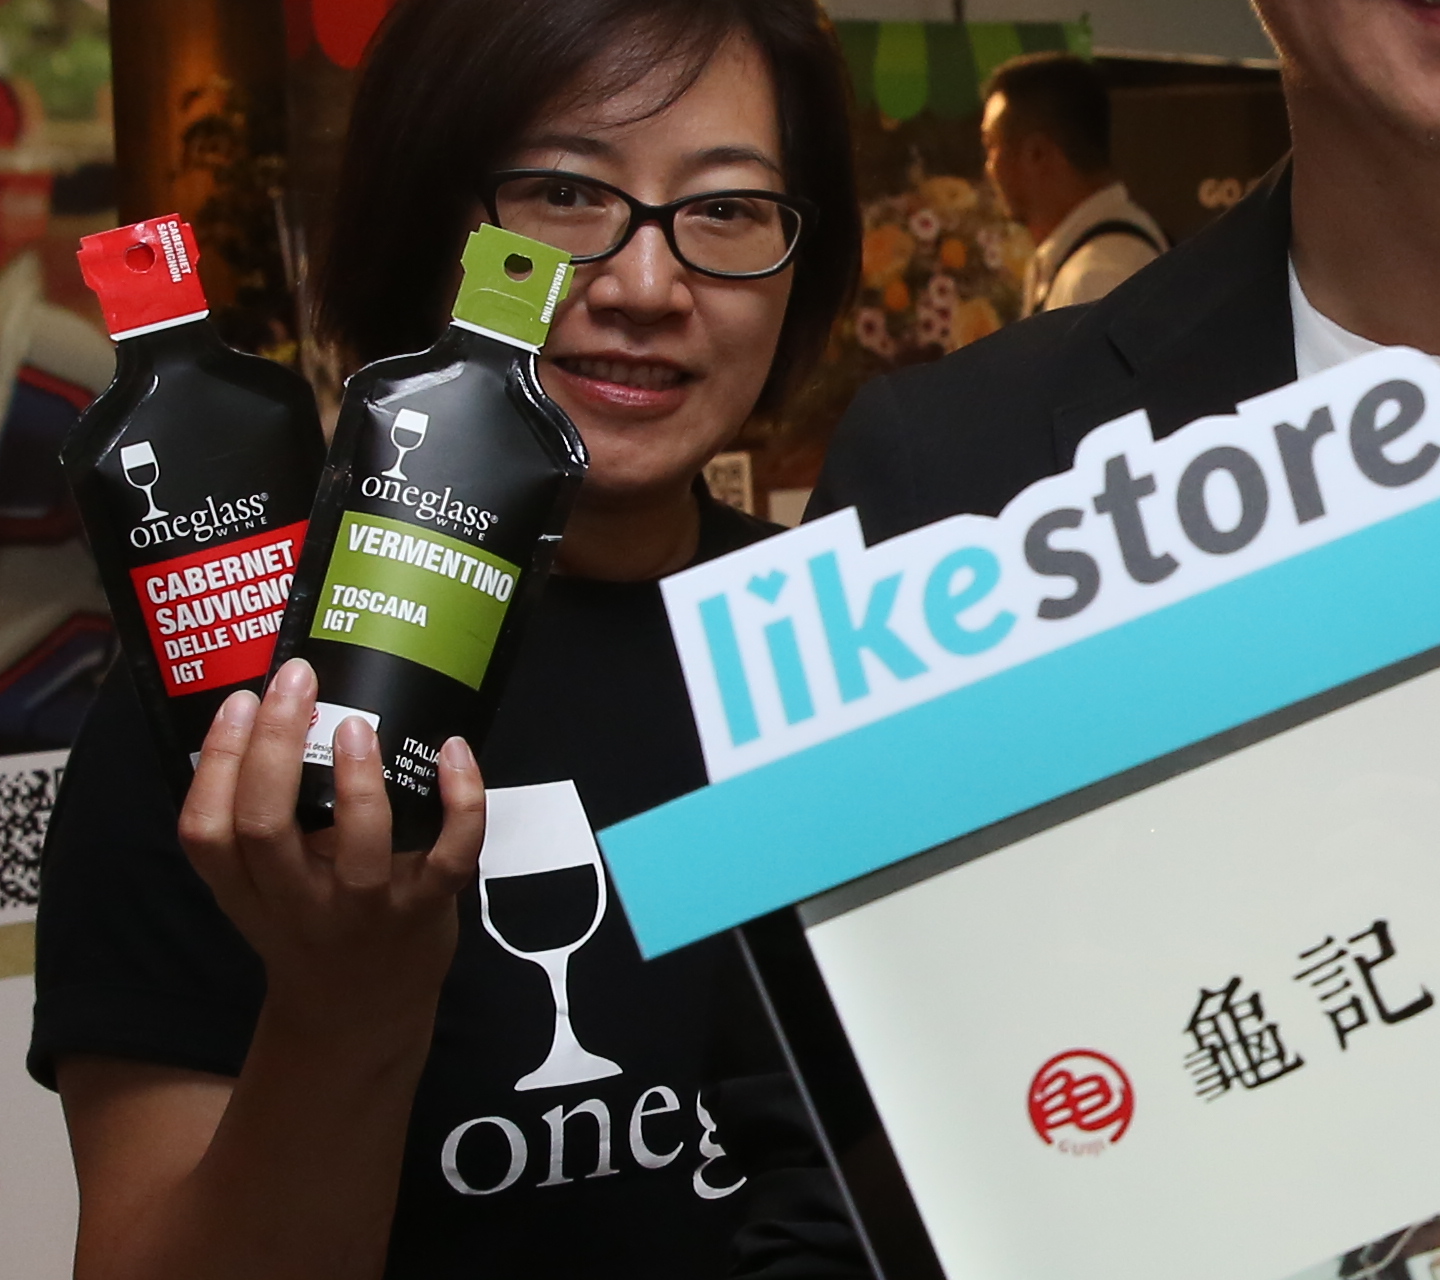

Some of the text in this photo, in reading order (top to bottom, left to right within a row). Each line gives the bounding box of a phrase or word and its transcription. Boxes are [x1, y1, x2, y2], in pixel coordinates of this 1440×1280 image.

[156, 223, 182, 283] SAUVIGNON
[167, 220, 192, 275] CABERNET
[540, 261, 569, 324] VERMENTINO
[215, 516, 268, 538] WINE
[432, 517, 486, 542] WINE
[145, 539, 295, 605] CABERNET
[347, 523, 513, 604] VERMENTINO
[322, 609, 359, 636] IGT
[330, 584, 428, 630] TOSCANA
[163, 626, 231, 661] DELLE
[171, 660, 204, 685] IGT
[395, 754, 427, 777] 100 ml
[396, 772, 416, 791] 13%
[1182, 918, 1435, 1104] 龜記
